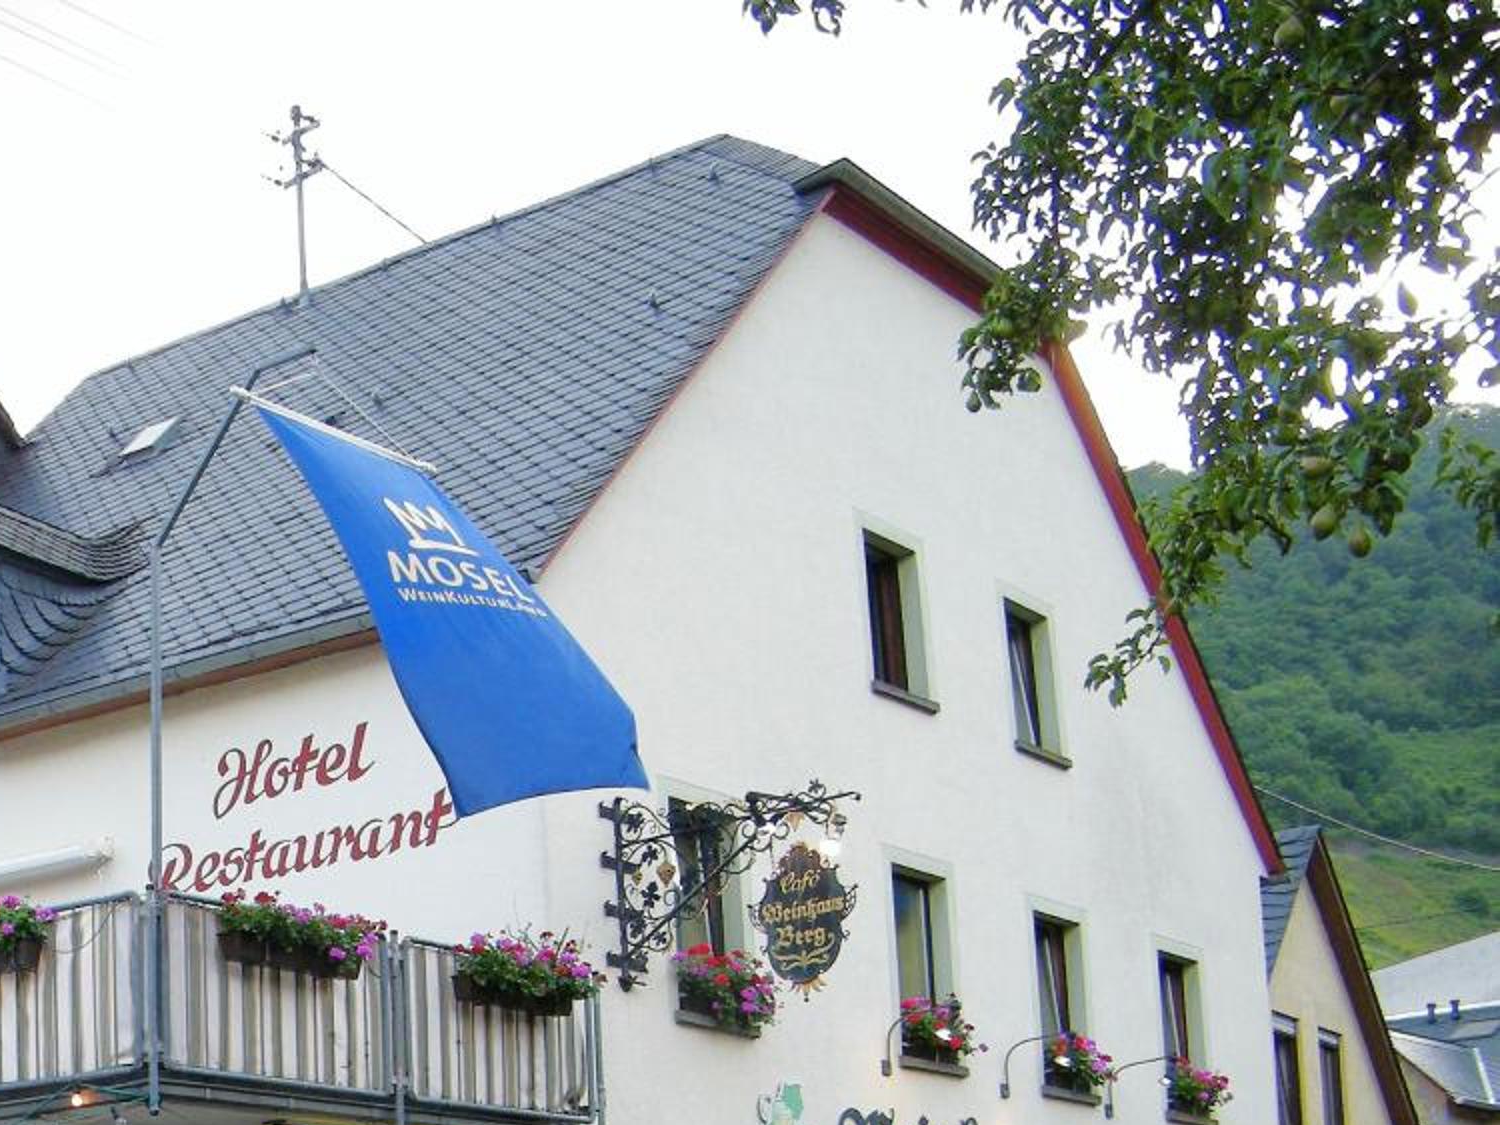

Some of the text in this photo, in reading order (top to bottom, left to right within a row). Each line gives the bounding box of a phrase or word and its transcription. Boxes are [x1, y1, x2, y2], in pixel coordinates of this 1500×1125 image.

[387, 550, 536, 605] MOSEL
[213, 721, 376, 820] Hotel
[148, 786, 460, 894] Restaurant
[761, 895, 845, 924] Weinhaus
[775, 926, 827, 947] Berg
